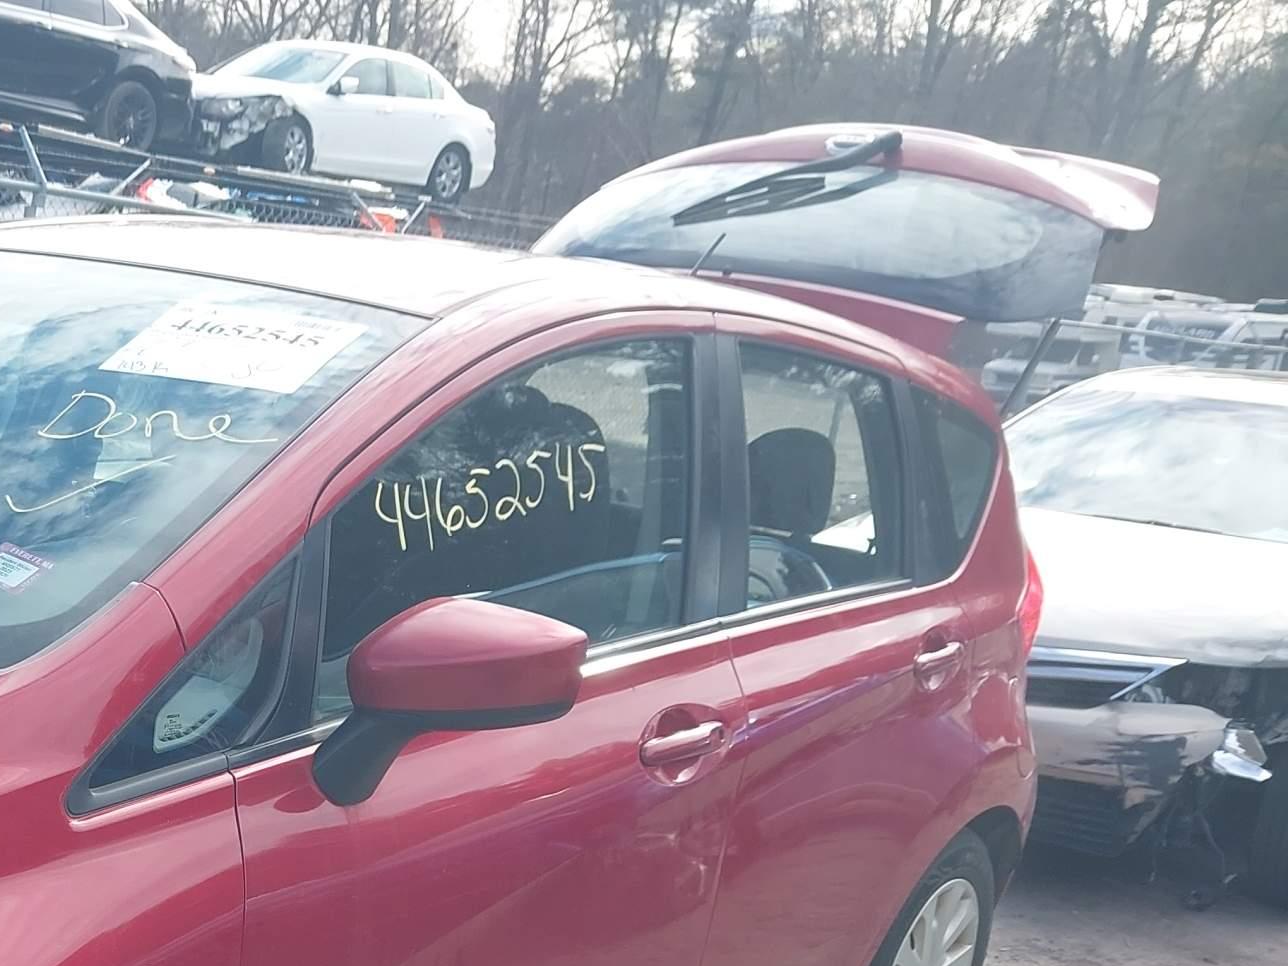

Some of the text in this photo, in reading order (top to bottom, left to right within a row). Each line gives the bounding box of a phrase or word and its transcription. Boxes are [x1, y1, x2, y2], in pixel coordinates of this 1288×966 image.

[170, 319, 325, 348] 44652545
[37, 389, 279, 444] Done
[374, 442, 606, 552] 44652545
